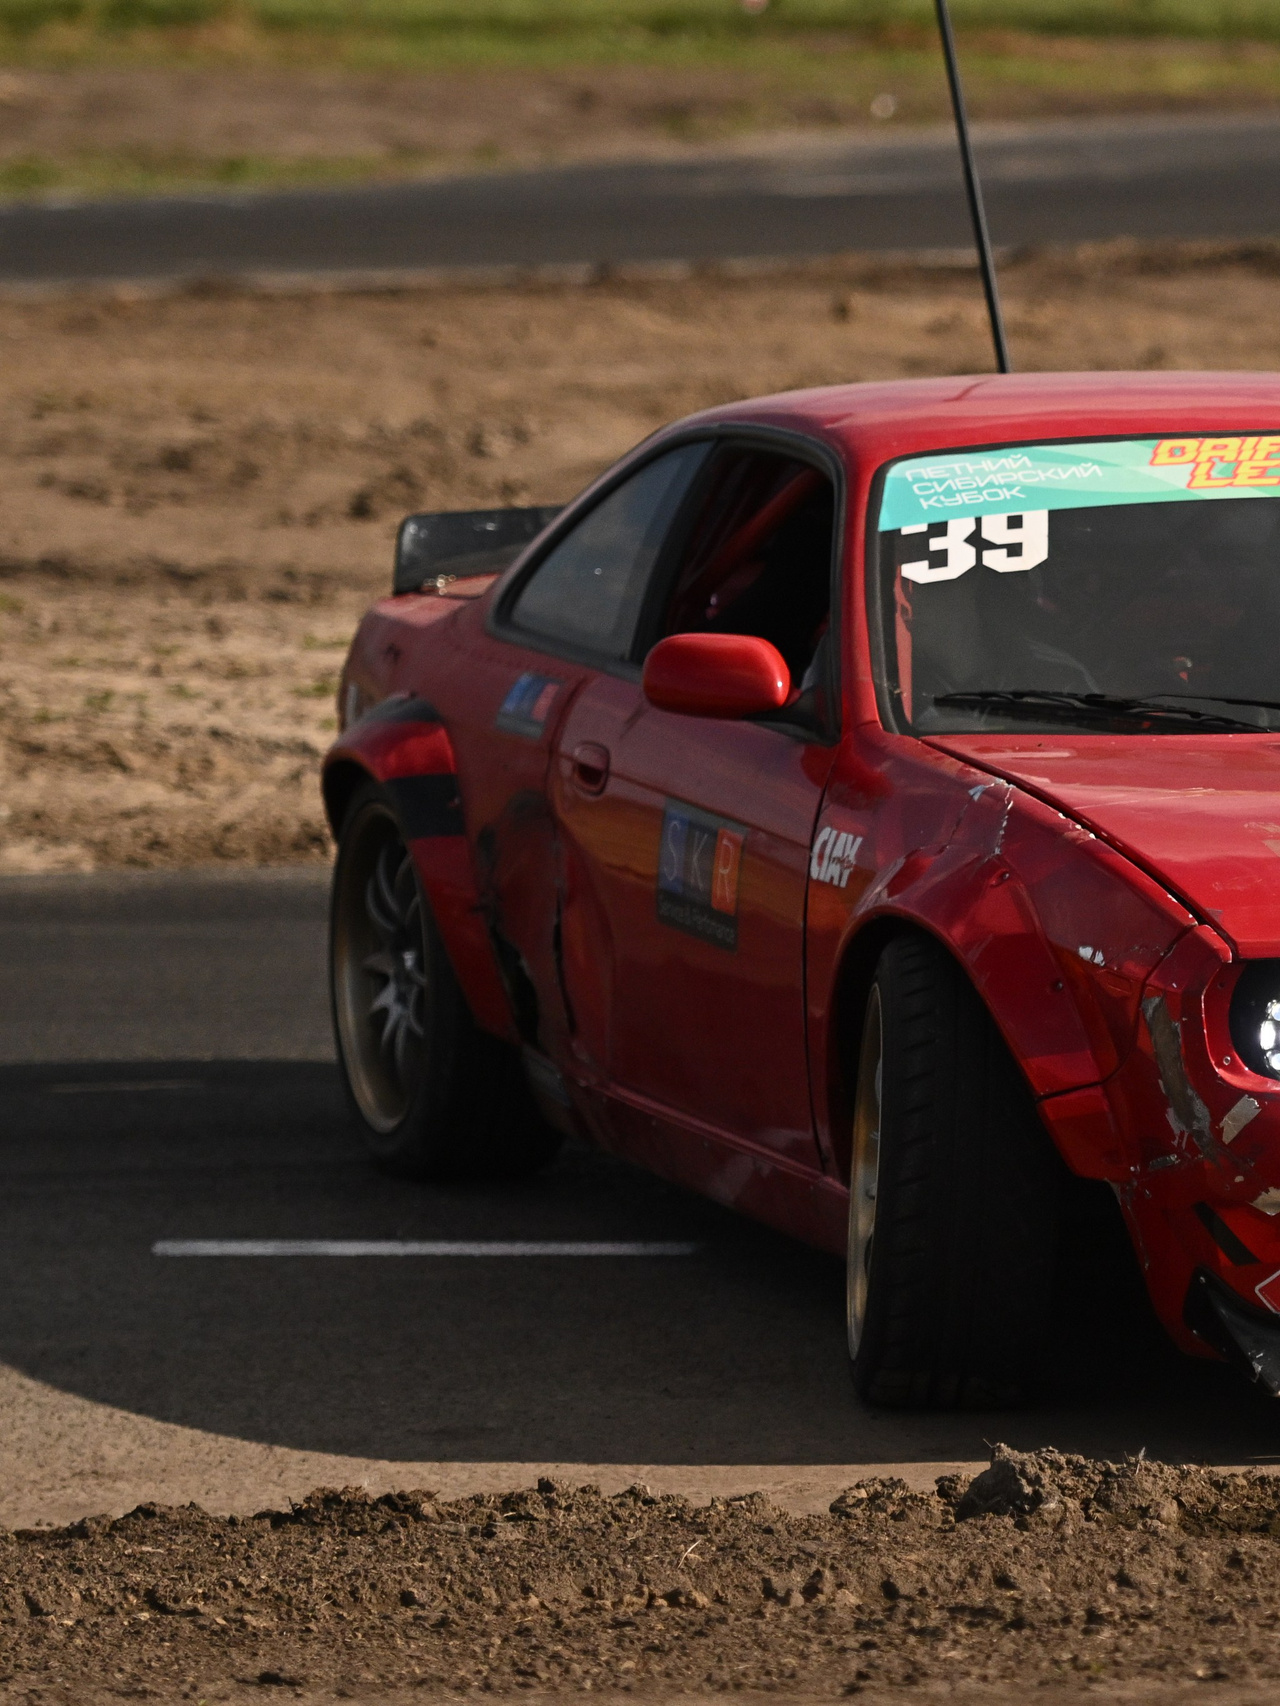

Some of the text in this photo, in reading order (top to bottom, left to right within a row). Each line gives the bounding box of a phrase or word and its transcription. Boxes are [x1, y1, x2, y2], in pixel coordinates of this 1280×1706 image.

[912, 462, 1103, 495] СИБИРСКИЙ
[919, 486, 1026, 509] КУБОК
[900, 509, 1049, 585] 39
